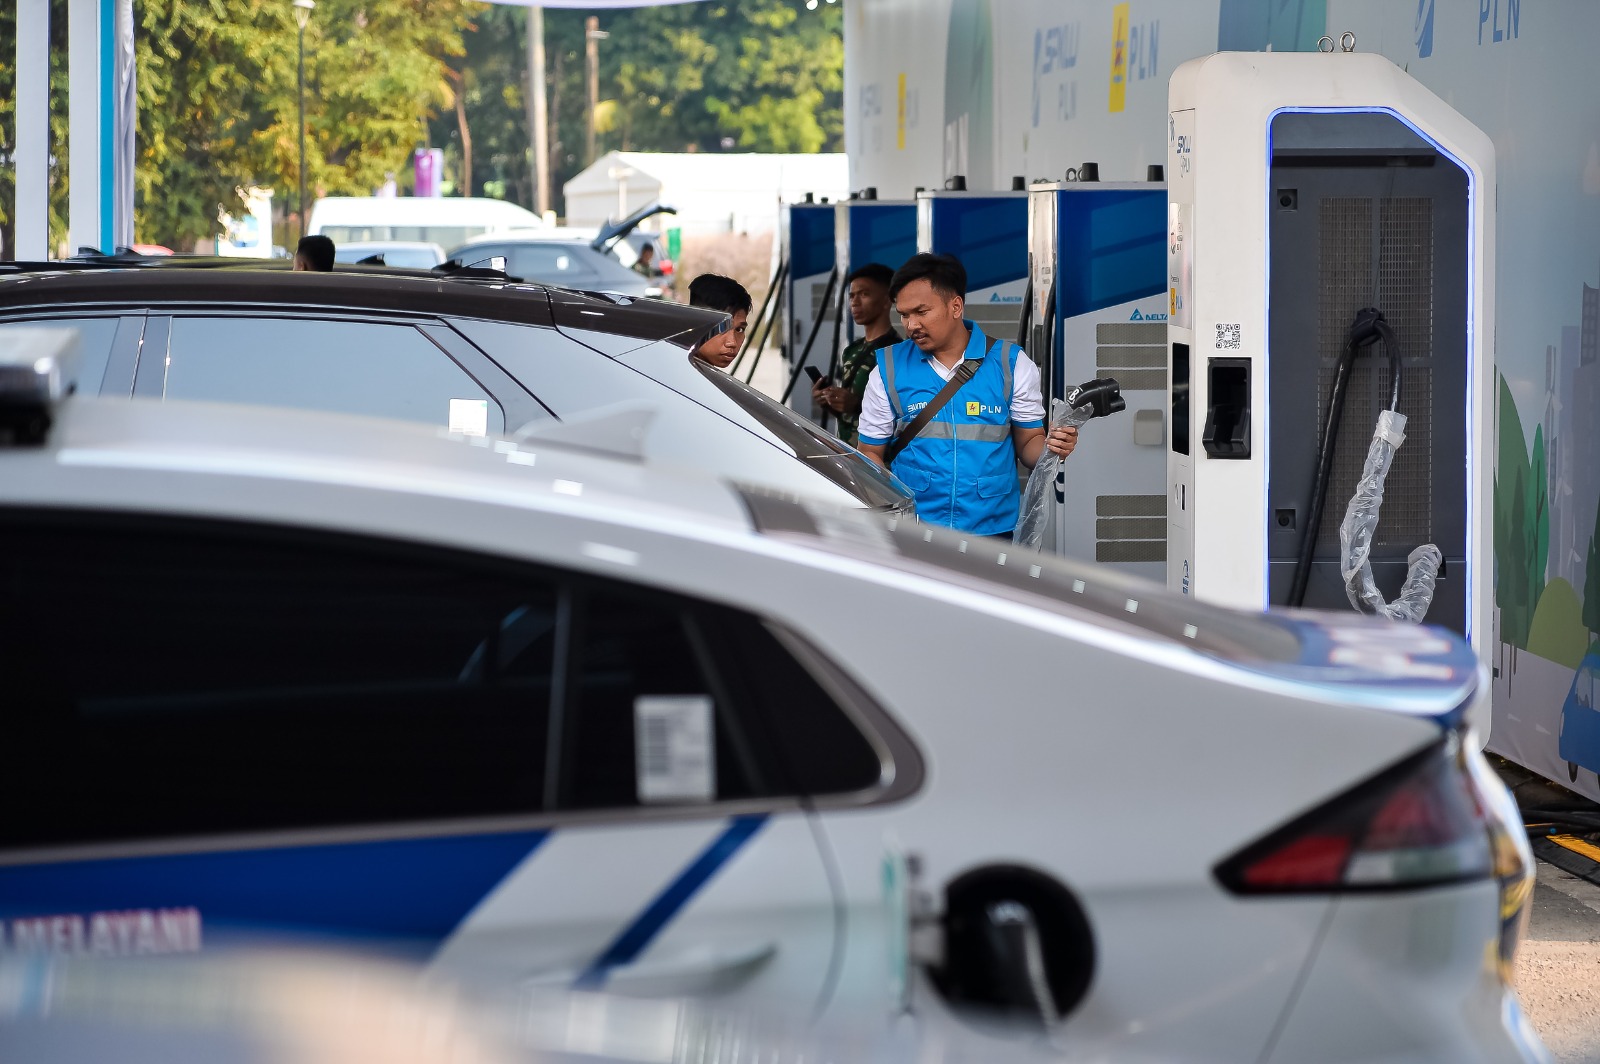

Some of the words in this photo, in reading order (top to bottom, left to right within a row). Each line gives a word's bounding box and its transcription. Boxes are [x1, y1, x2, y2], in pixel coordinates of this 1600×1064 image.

[1478, 0, 1520, 45] PLN
[1128, 19, 1160, 83] PLN
[980, 404, 1002, 414] PLN
[12, 905, 202, 953] MELAYANI
